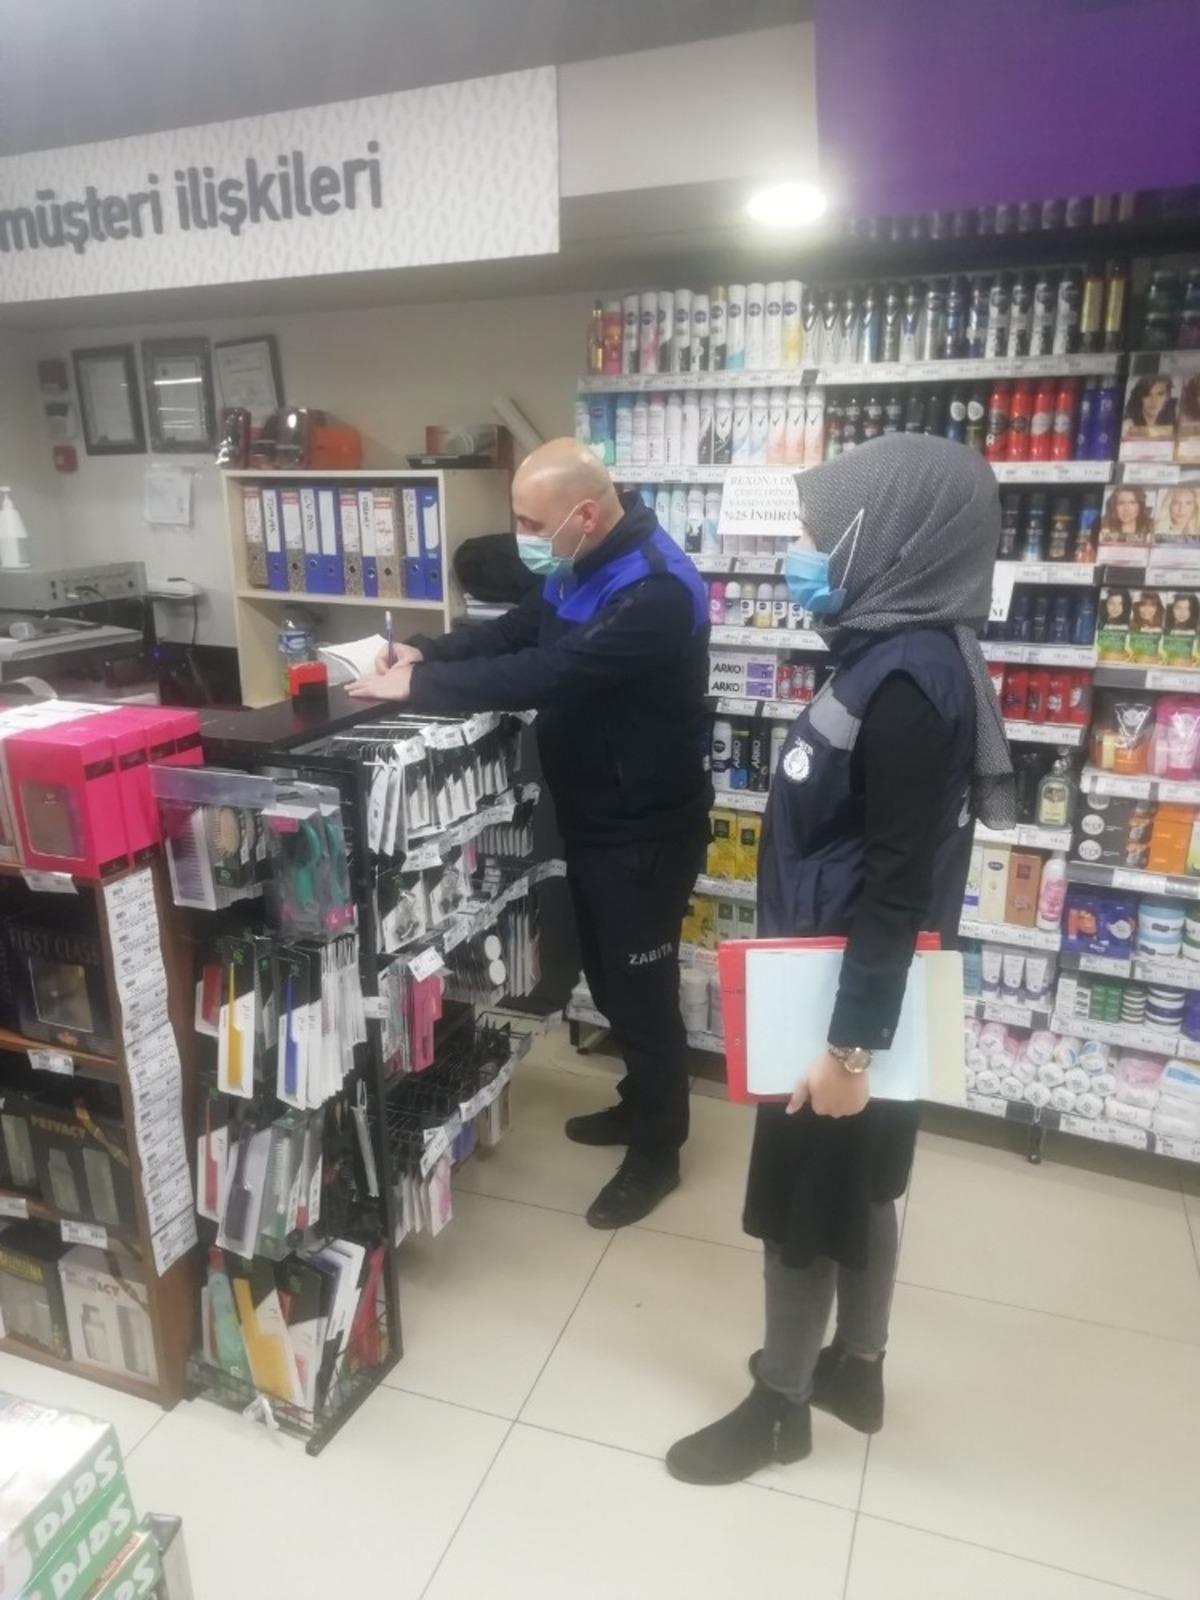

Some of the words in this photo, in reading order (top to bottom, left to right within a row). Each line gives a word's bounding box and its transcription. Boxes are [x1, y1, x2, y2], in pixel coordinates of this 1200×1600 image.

[0, 174, 163, 256] müşteri
[175, 141, 383, 236] ilişkileri
[712, 662, 742, 674] ARKO
[711, 680, 741, 692] ARKO
